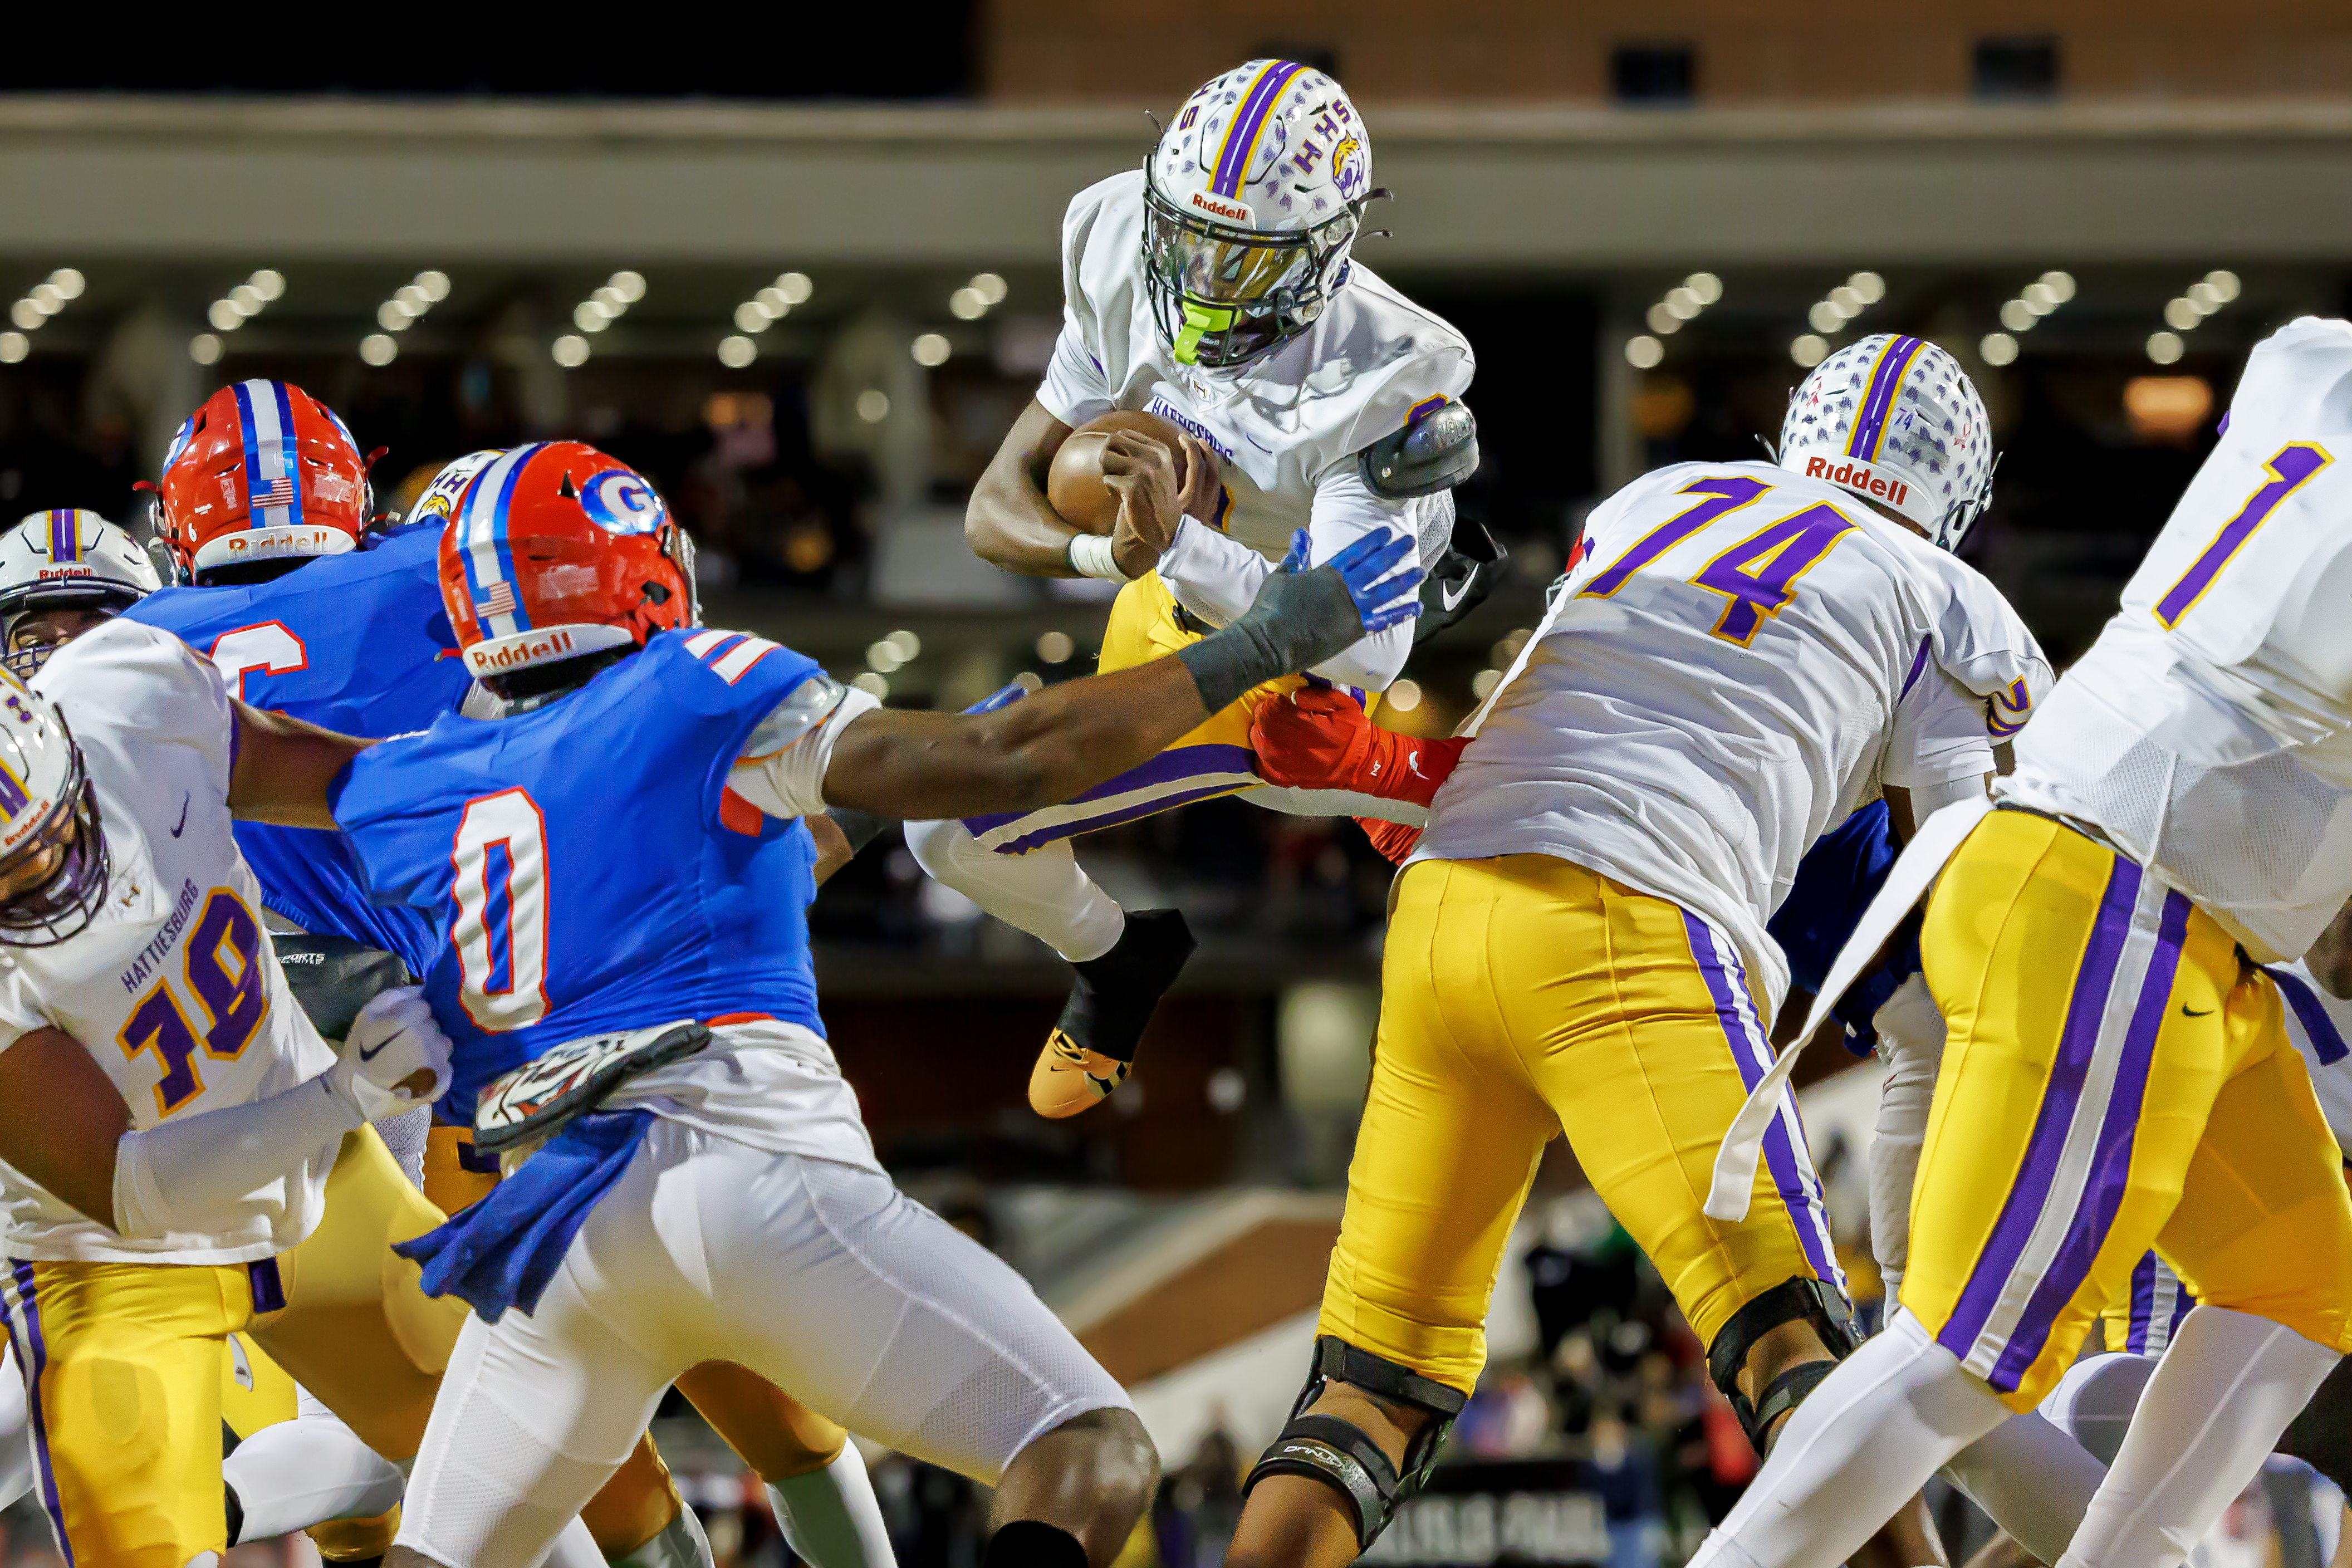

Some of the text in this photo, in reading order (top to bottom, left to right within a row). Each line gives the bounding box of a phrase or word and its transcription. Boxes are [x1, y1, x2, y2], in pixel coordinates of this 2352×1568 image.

[1292, 99, 1352, 176] HHS
[1193, 193, 1247, 221] Riddell
[599, 475, 659, 533] G
[1806, 456, 1908, 506] Riddell
[1575, 476, 1864, 649] 74
[473, 631, 572, 670] Riddell
[120, 877, 199, 994] HATTIESBURG
[450, 785, 552, 1035] 0
